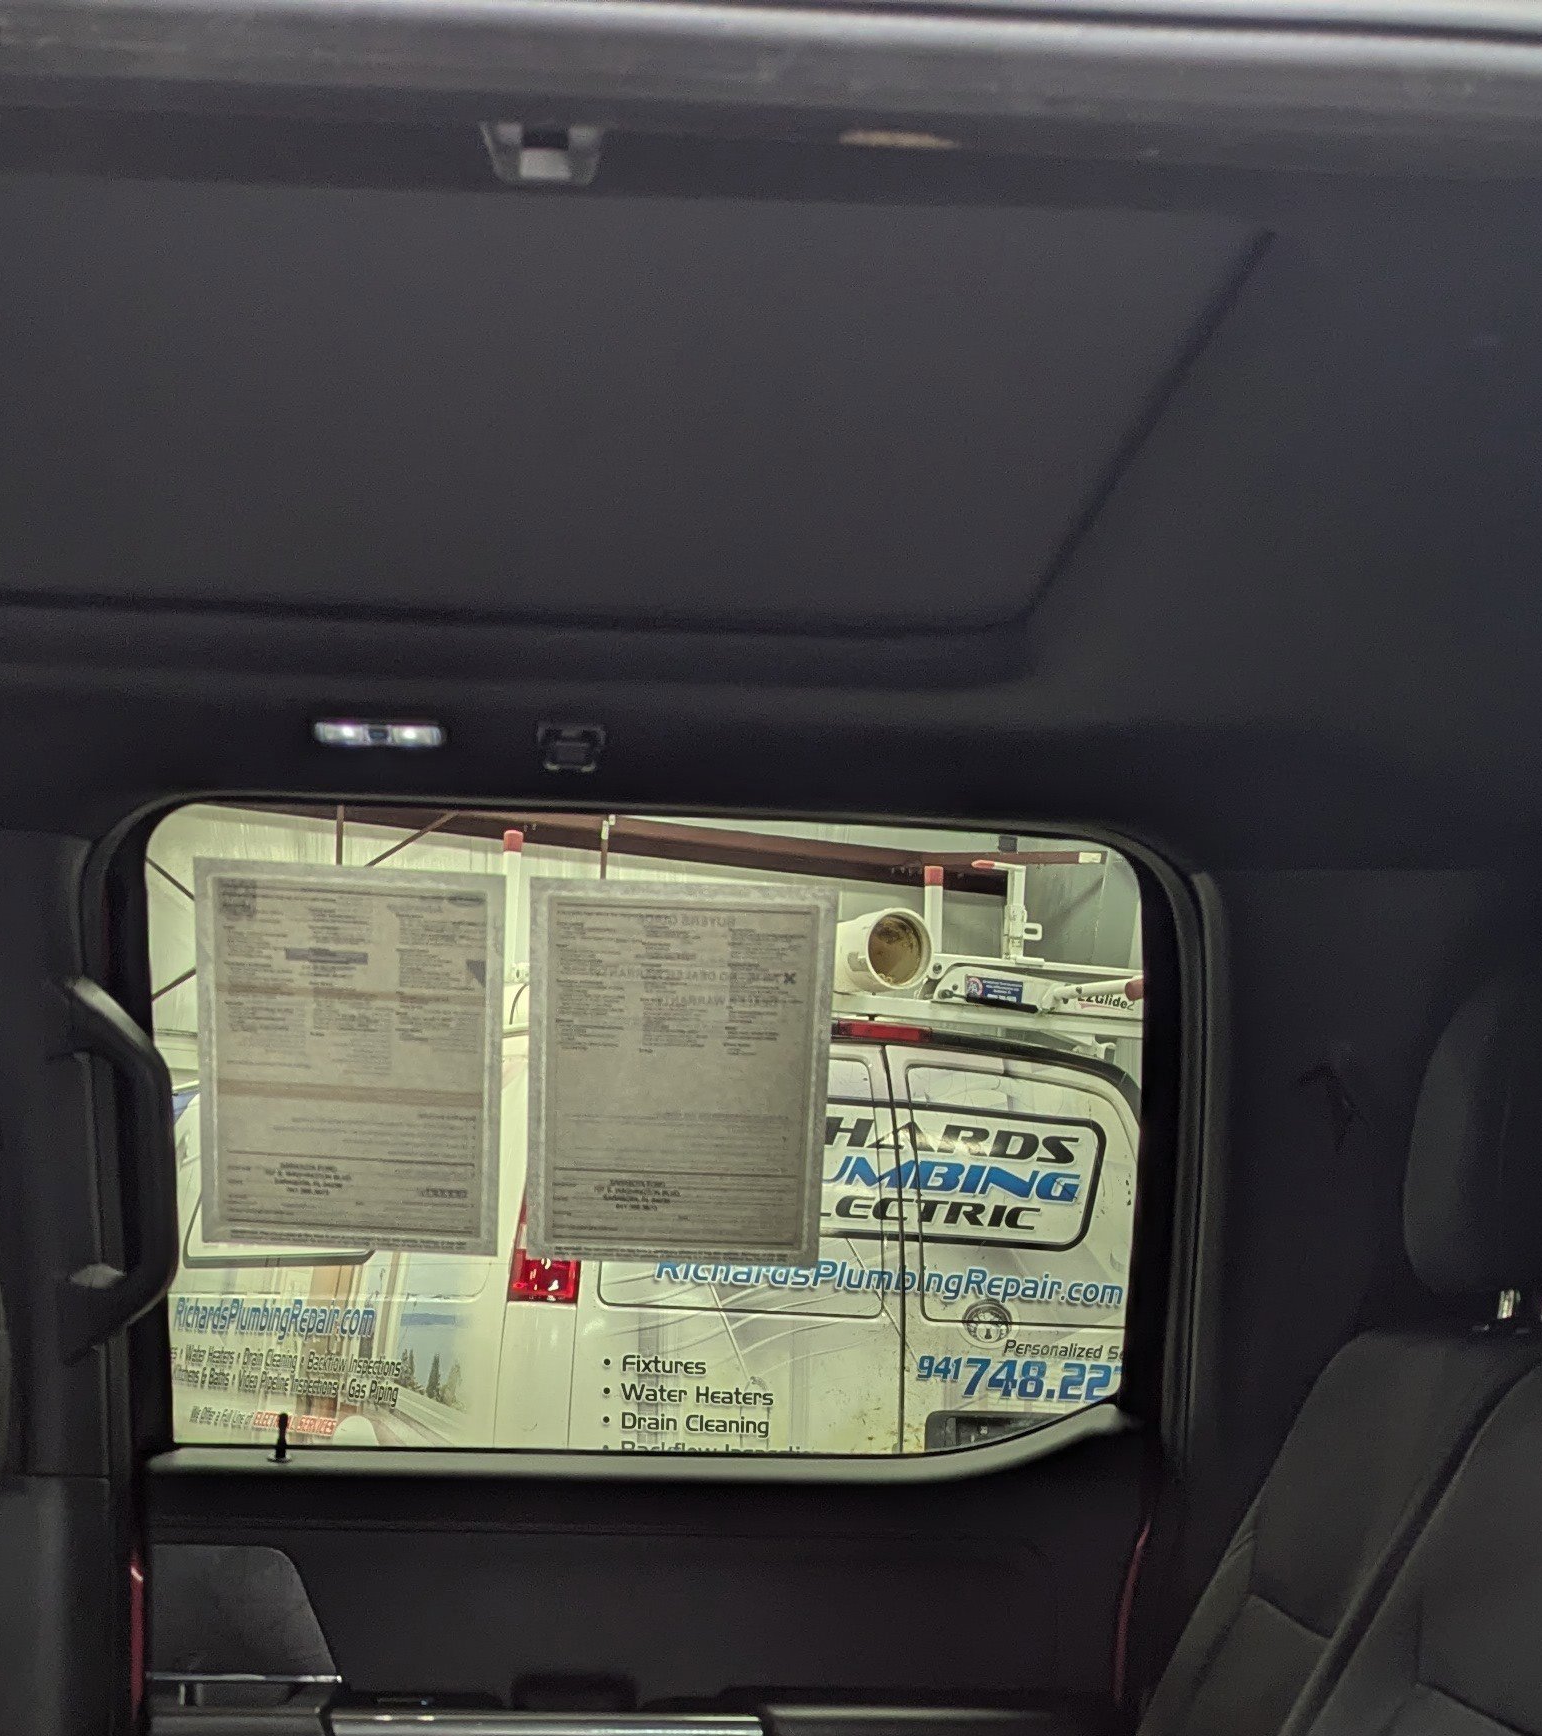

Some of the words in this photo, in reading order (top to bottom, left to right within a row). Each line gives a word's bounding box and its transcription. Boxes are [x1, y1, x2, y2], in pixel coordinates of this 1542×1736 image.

[824, 1116, 1079, 1164] HARDS
[176, 1298, 375, 1341] RichardsPlumbingRepair.com
[1003, 1339, 1104, 1359] Personalized
[264, 1349, 297, 1373] Cleaning
[348, 1353, 401, 1377] Inspections
[622, 1355, 707, 1375] Fixtures
[917, 1355, 962, 1380] 941
[348, 1378, 366, 1399] Gas
[368, 1380, 399, 1407] Piping
[620, 1383, 687, 1402] Water
[695, 1386, 774, 1406] Heaters
[621, 1412, 677, 1431] Drain
[685, 1414, 769, 1438] Cleaning
